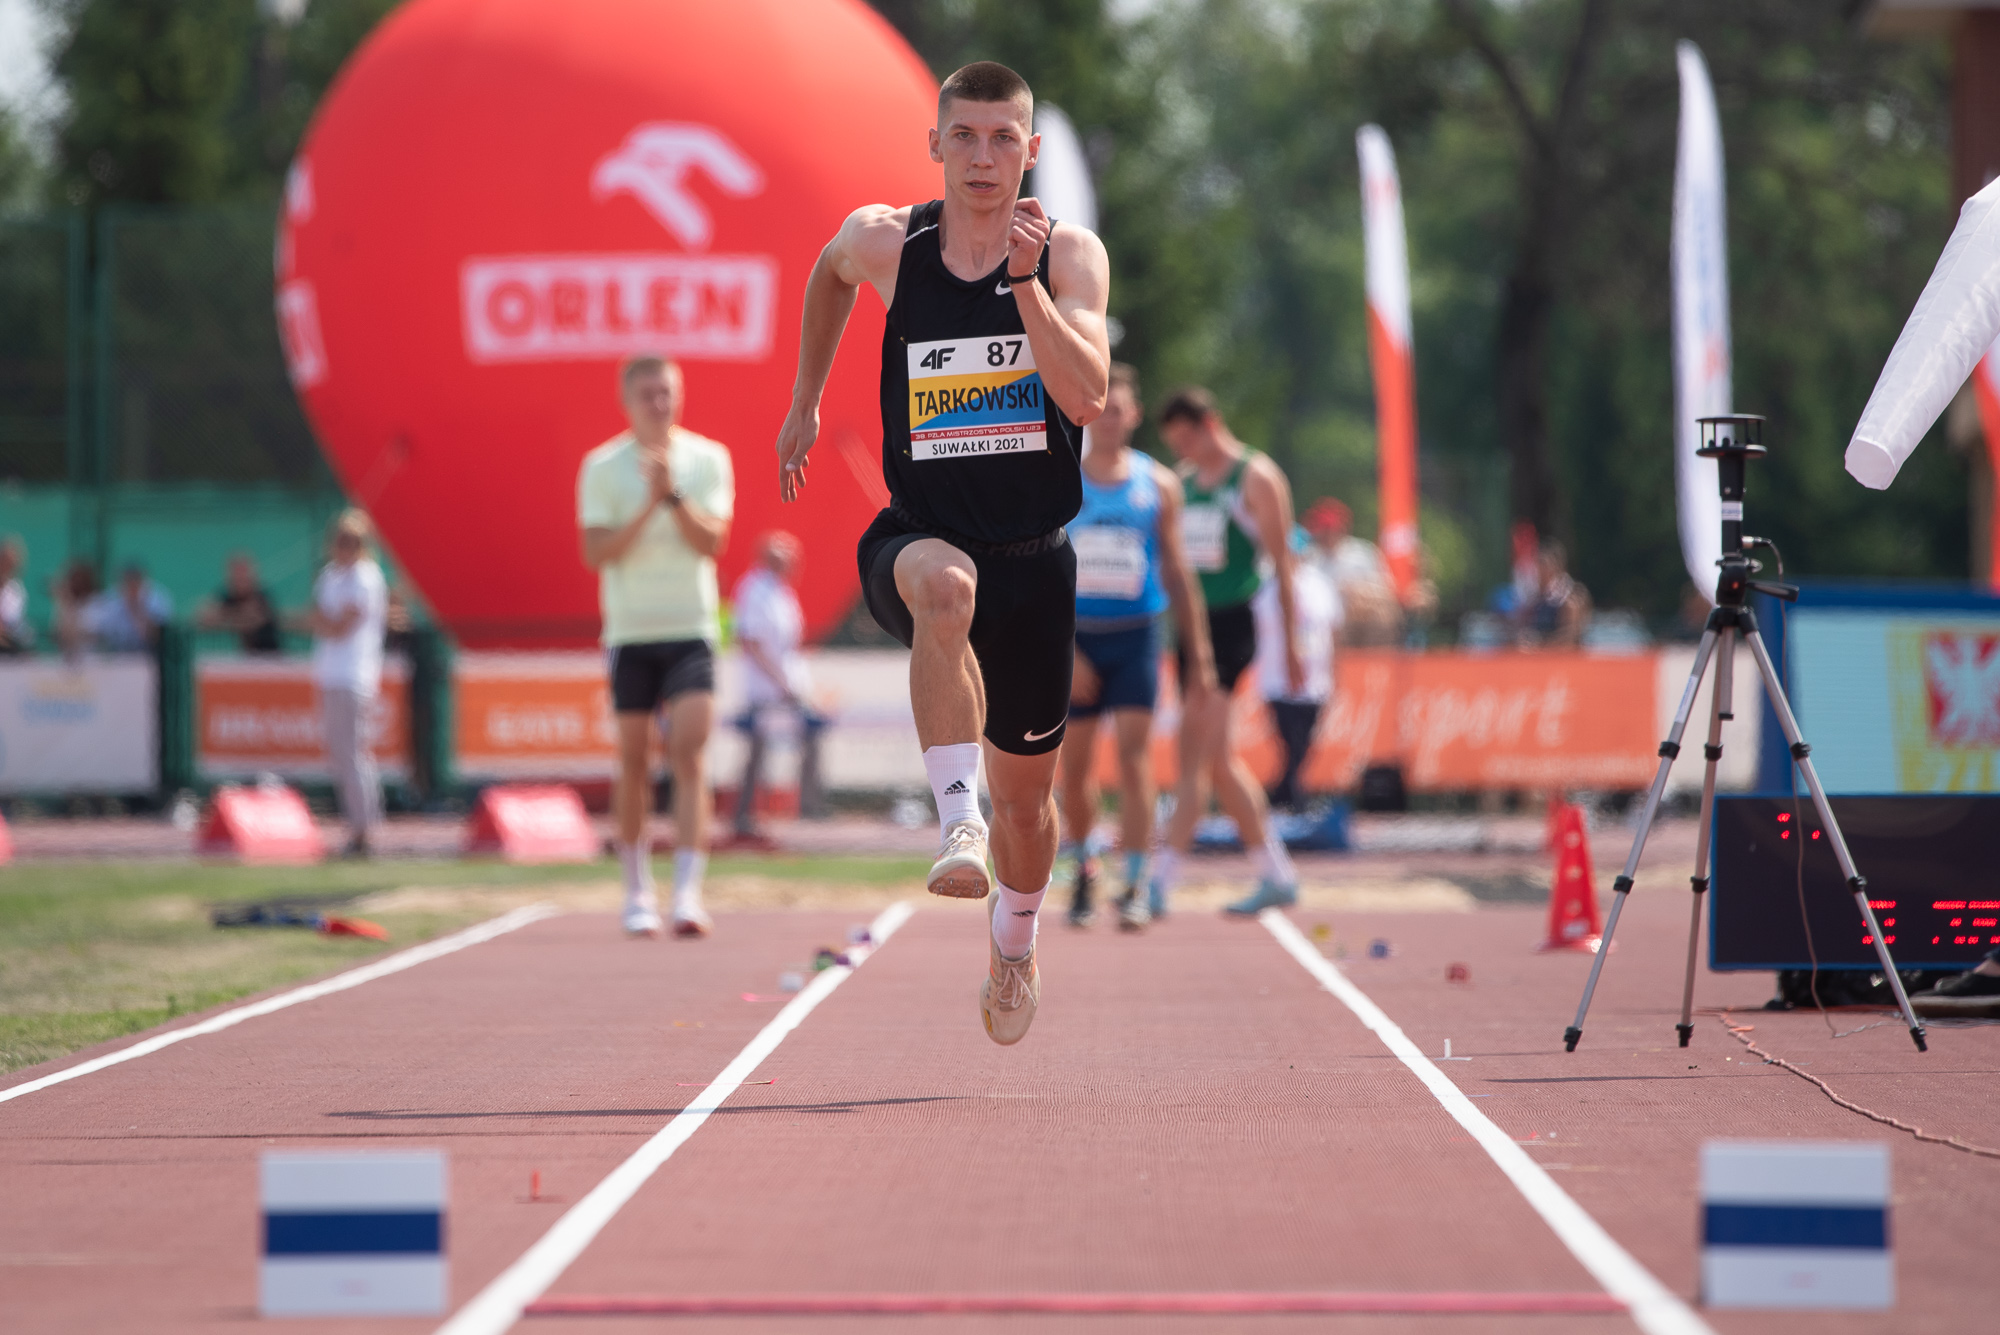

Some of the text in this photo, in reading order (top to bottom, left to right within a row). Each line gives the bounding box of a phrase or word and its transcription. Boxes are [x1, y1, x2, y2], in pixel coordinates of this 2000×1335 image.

[483, 276, 745, 339] ORLEN
[920, 347, 956, 370] 4F
[987, 340, 1022, 366] 87
[915, 382, 1039, 416] TARKOWSKI
[932, 437, 1025, 455] SUWAŁKI 2021
[944, 788, 970, 796] adidas
